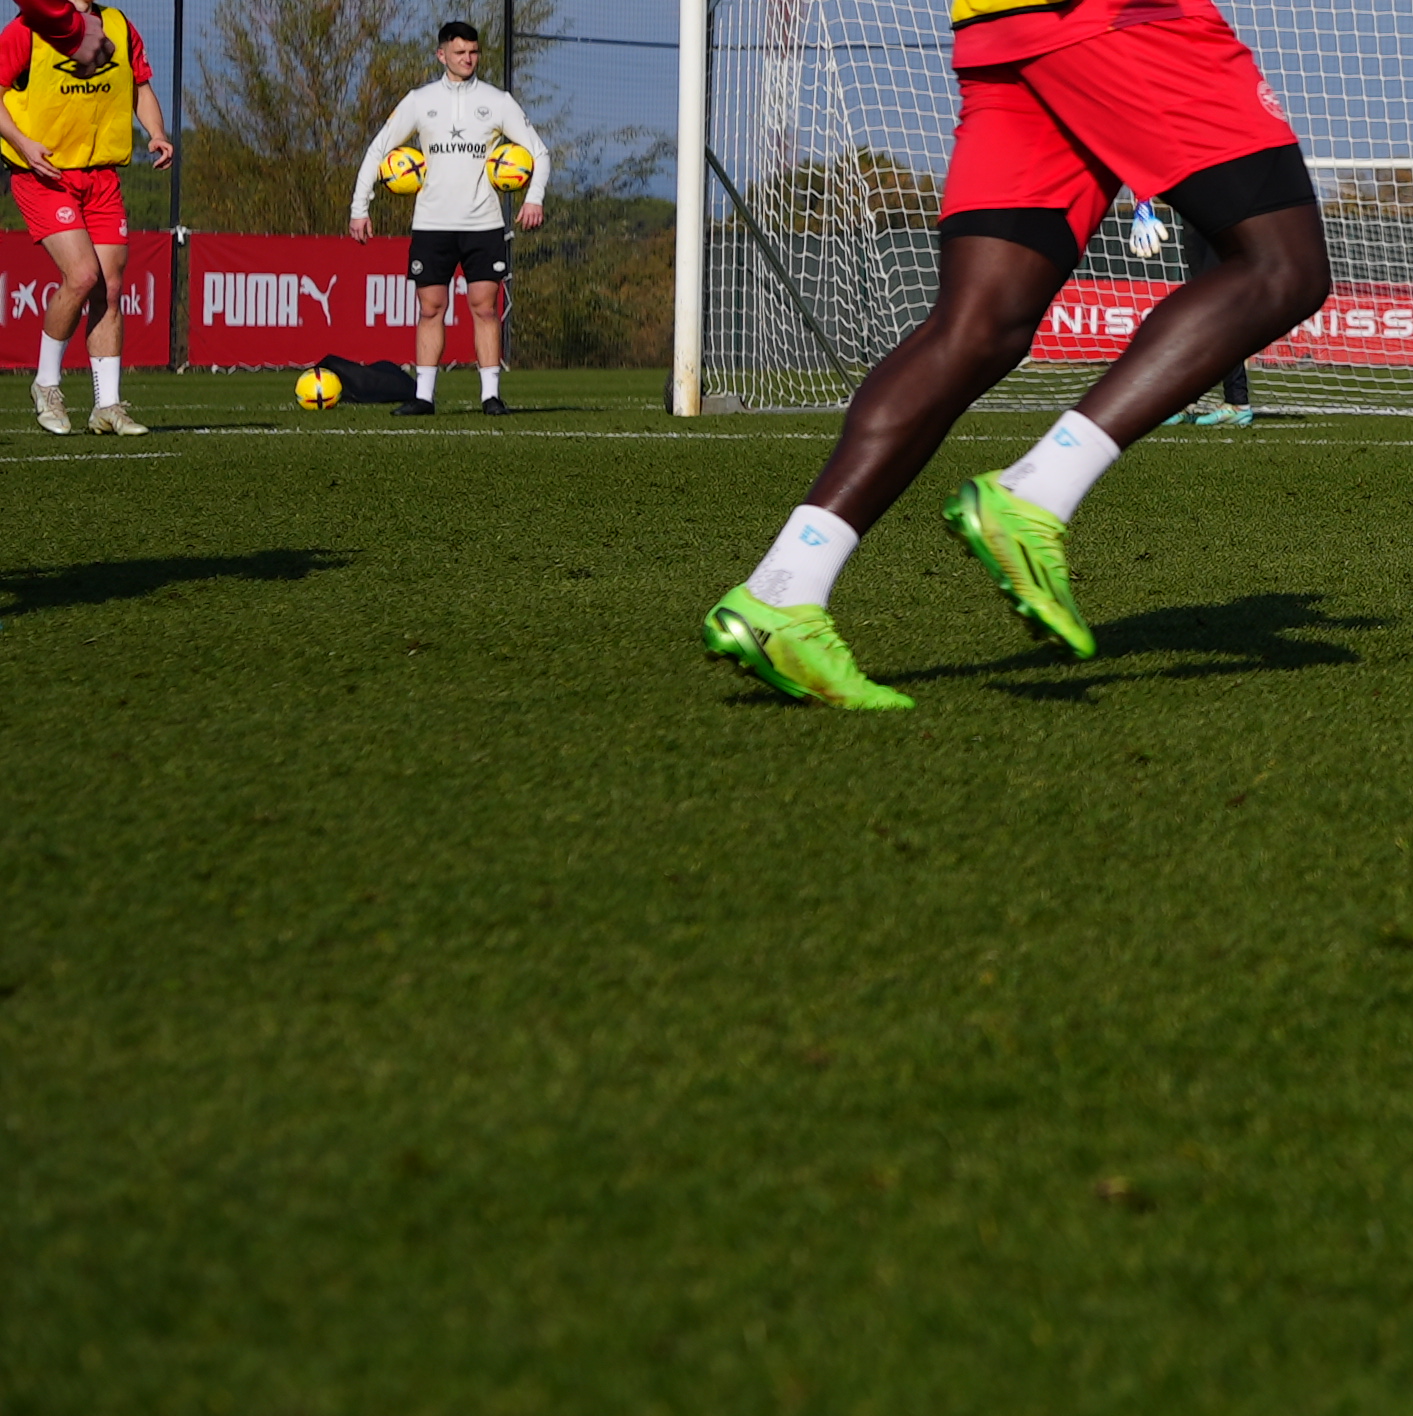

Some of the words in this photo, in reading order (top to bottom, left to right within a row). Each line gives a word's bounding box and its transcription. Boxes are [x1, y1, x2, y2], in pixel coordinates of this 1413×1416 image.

[60, 82, 111, 95] umbro
[429, 143, 487, 155] HOLLYWOOD
[203, 272, 299, 326] PUMA
